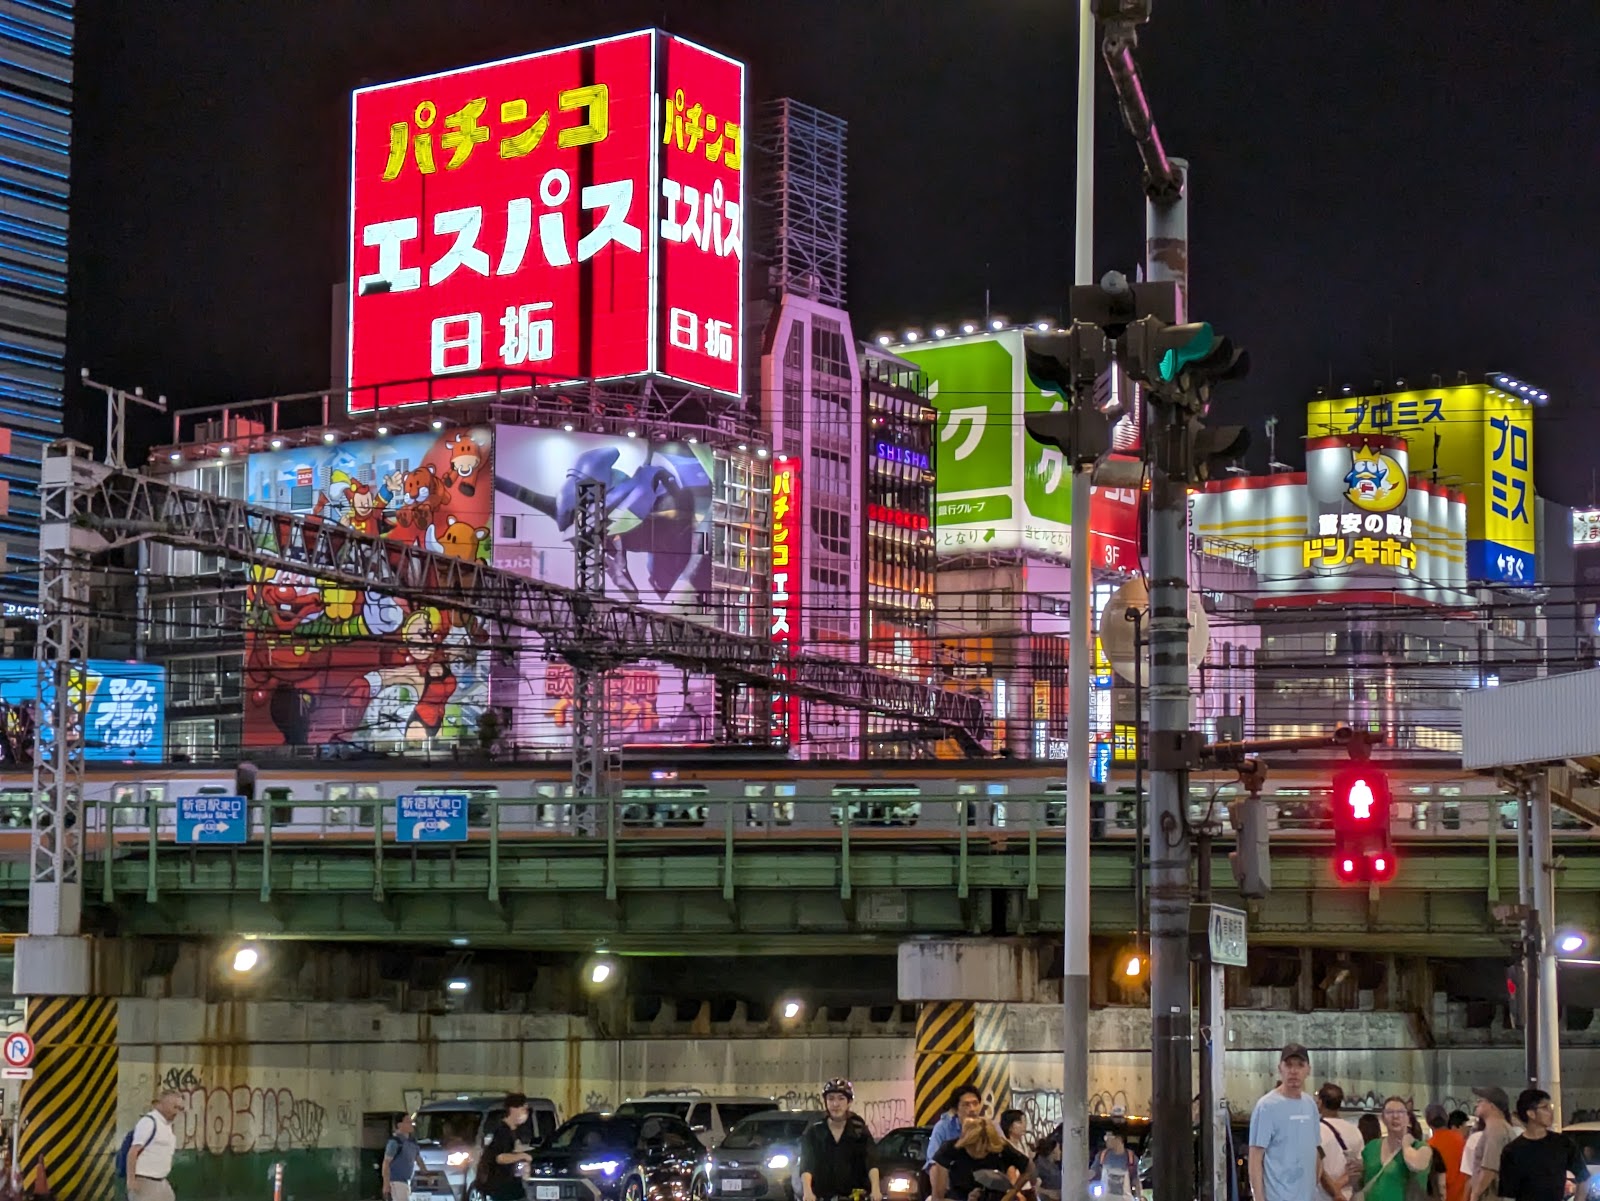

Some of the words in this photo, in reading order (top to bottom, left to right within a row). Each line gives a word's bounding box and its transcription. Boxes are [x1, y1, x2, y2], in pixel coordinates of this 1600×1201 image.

[381, 83, 609, 182] パチンコ
[663, 88, 741, 171] パチンコ
[358, 168, 642, 297] エスパス
[660, 178, 741, 262] エスパス
[430, 301, 554, 376] 日拓
[669, 306, 733, 363] 日拓
[1344, 398, 1446, 433] プロミス
[879, 443, 928, 469] SHISHA
[1105, 544, 1120, 564] 3F
[1506, 555, 1525, 580] すぐ
[109, 678, 156, 702] マックで
[181, 798, 242, 812] 新宿駅東口
[401, 797, 462, 810] 新宿駅東口
